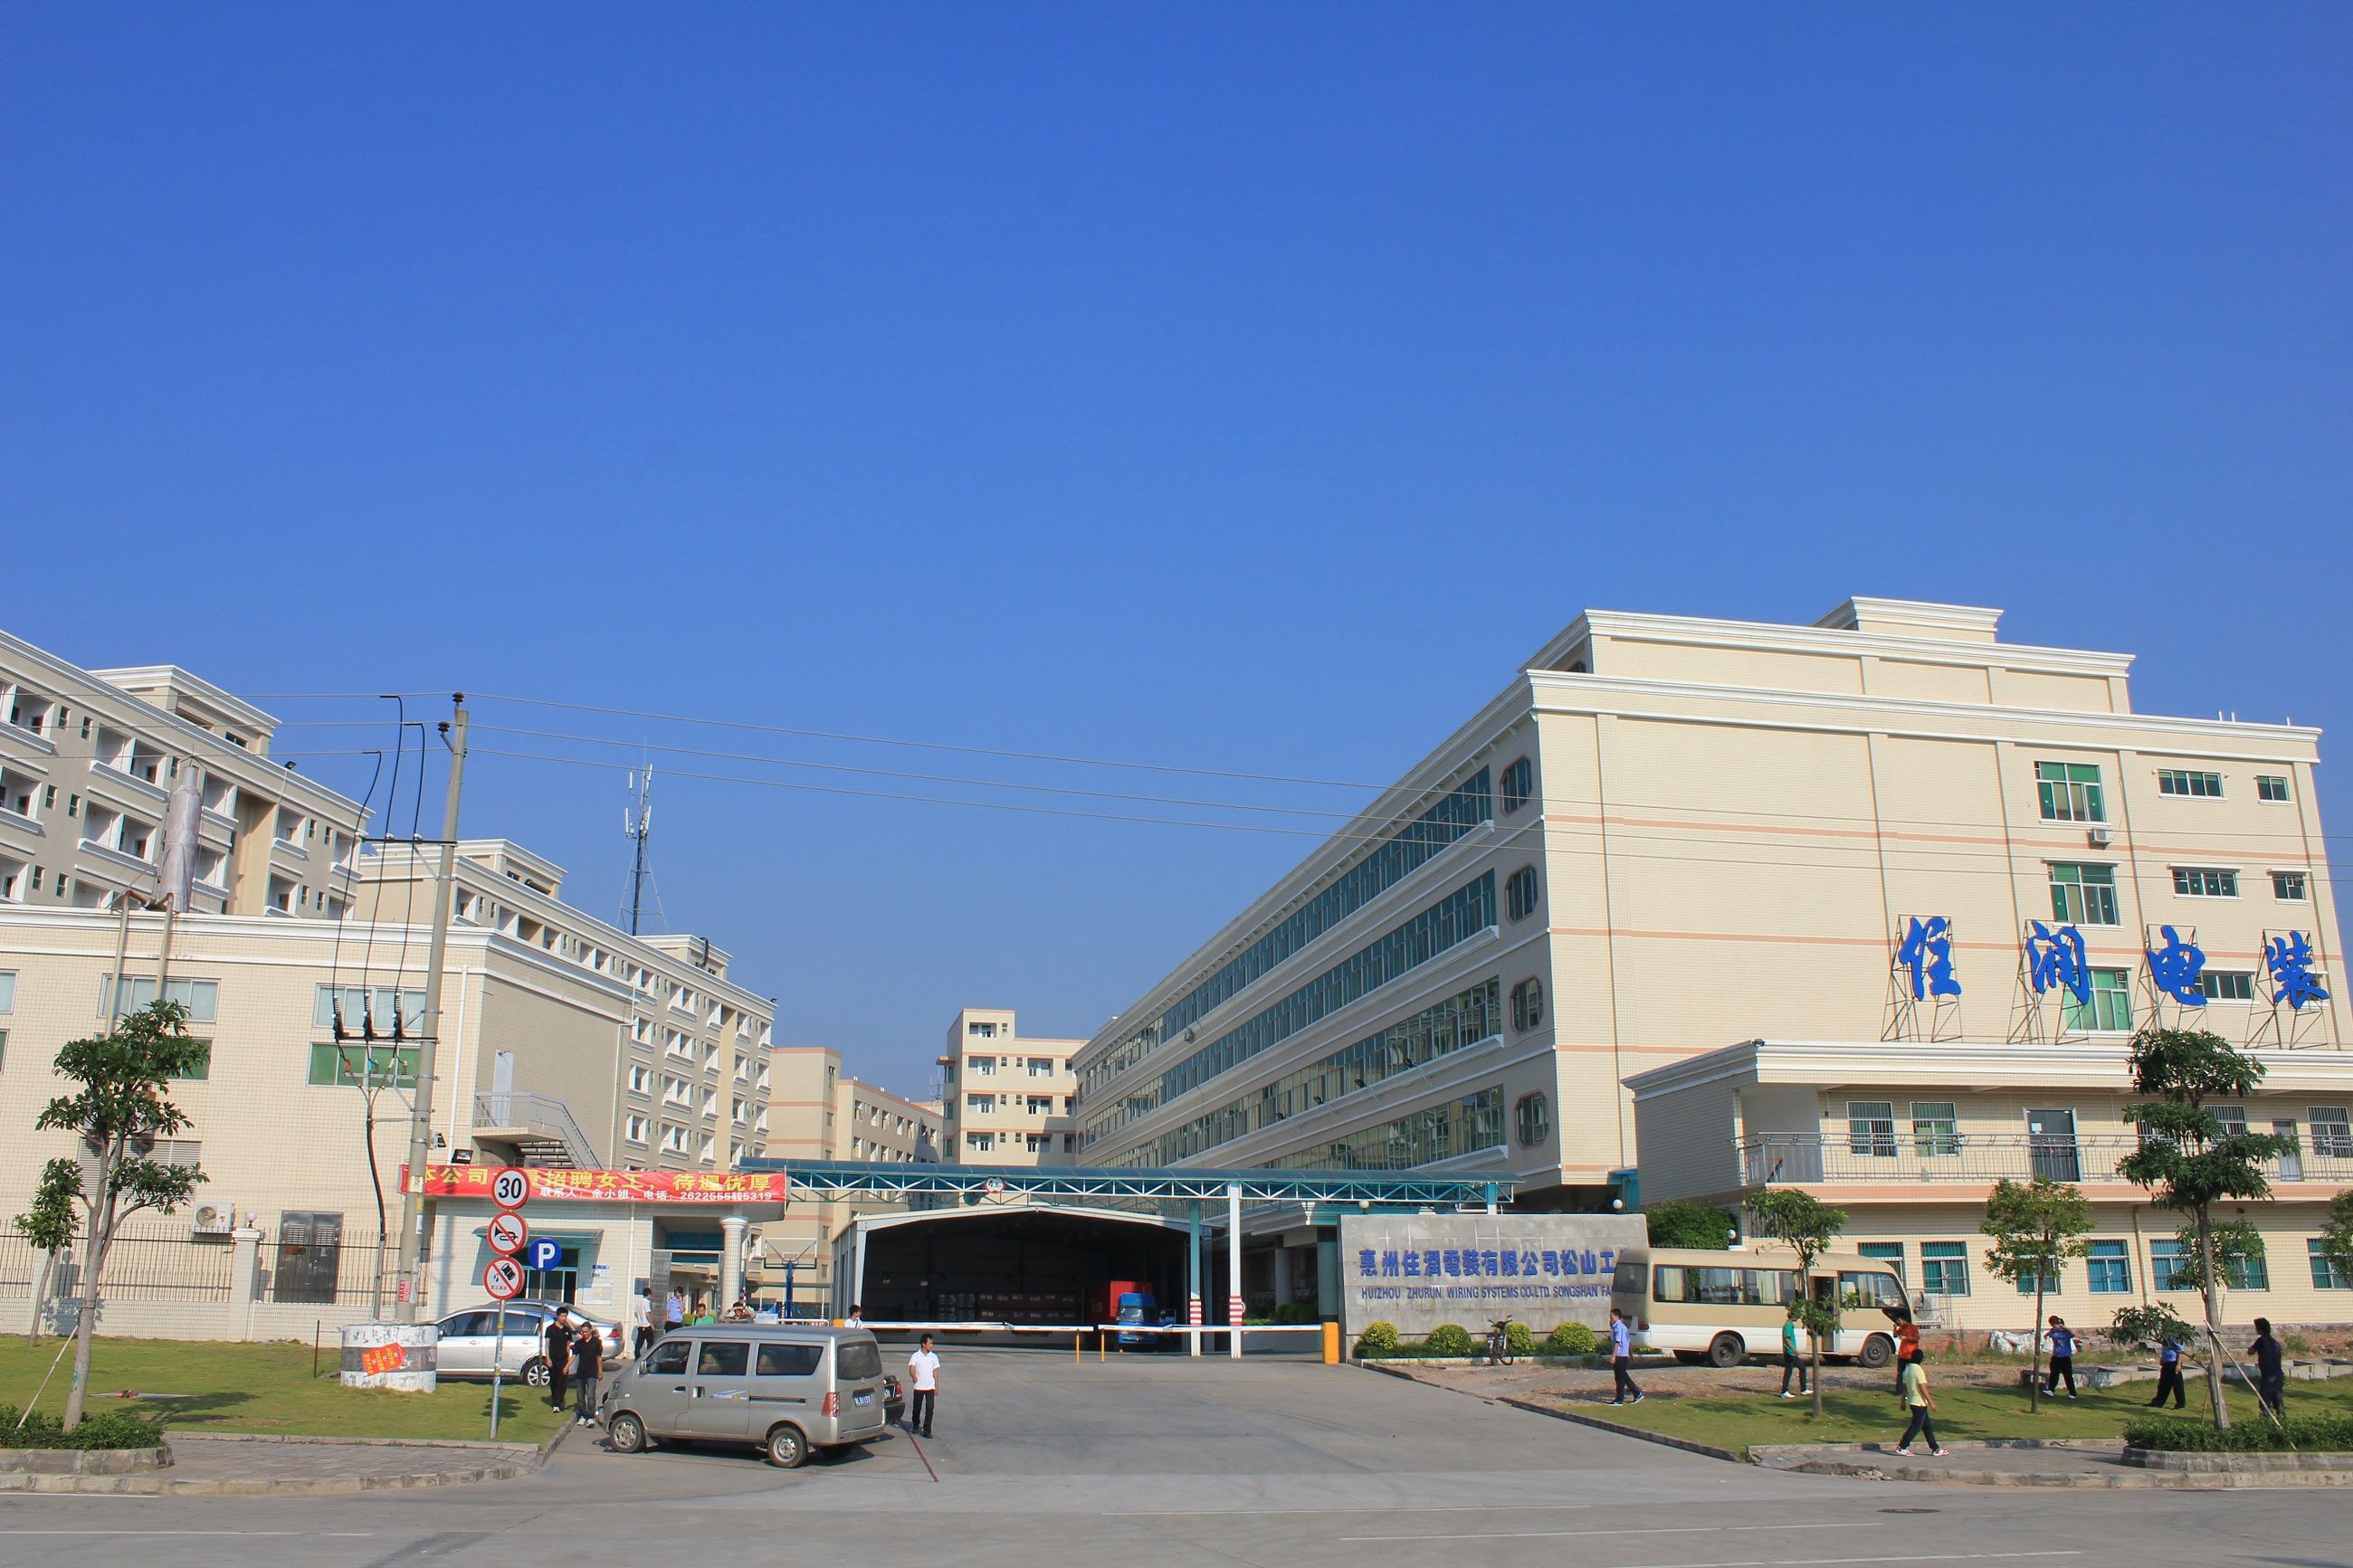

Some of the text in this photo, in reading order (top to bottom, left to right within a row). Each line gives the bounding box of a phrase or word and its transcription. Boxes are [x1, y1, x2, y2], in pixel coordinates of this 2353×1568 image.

[1898, 917, 2329, 1010] 住润电装
[498, 1177, 522, 1199] 30
[538, 1242, 556, 1269] P
[1358, 1250, 1627, 1277] 惠州住潤電裝有限公司松山工
[1361, 1287, 1401, 1299] HUIZHOU
[1406, 1286, 1443, 1299] ZHURUN
[1447, 1286, 1479, 1299] WIRING
[1481, 1285, 1519, 1298] SYSTEMS
[1553, 1285, 1598, 1297] SONGSHAN
